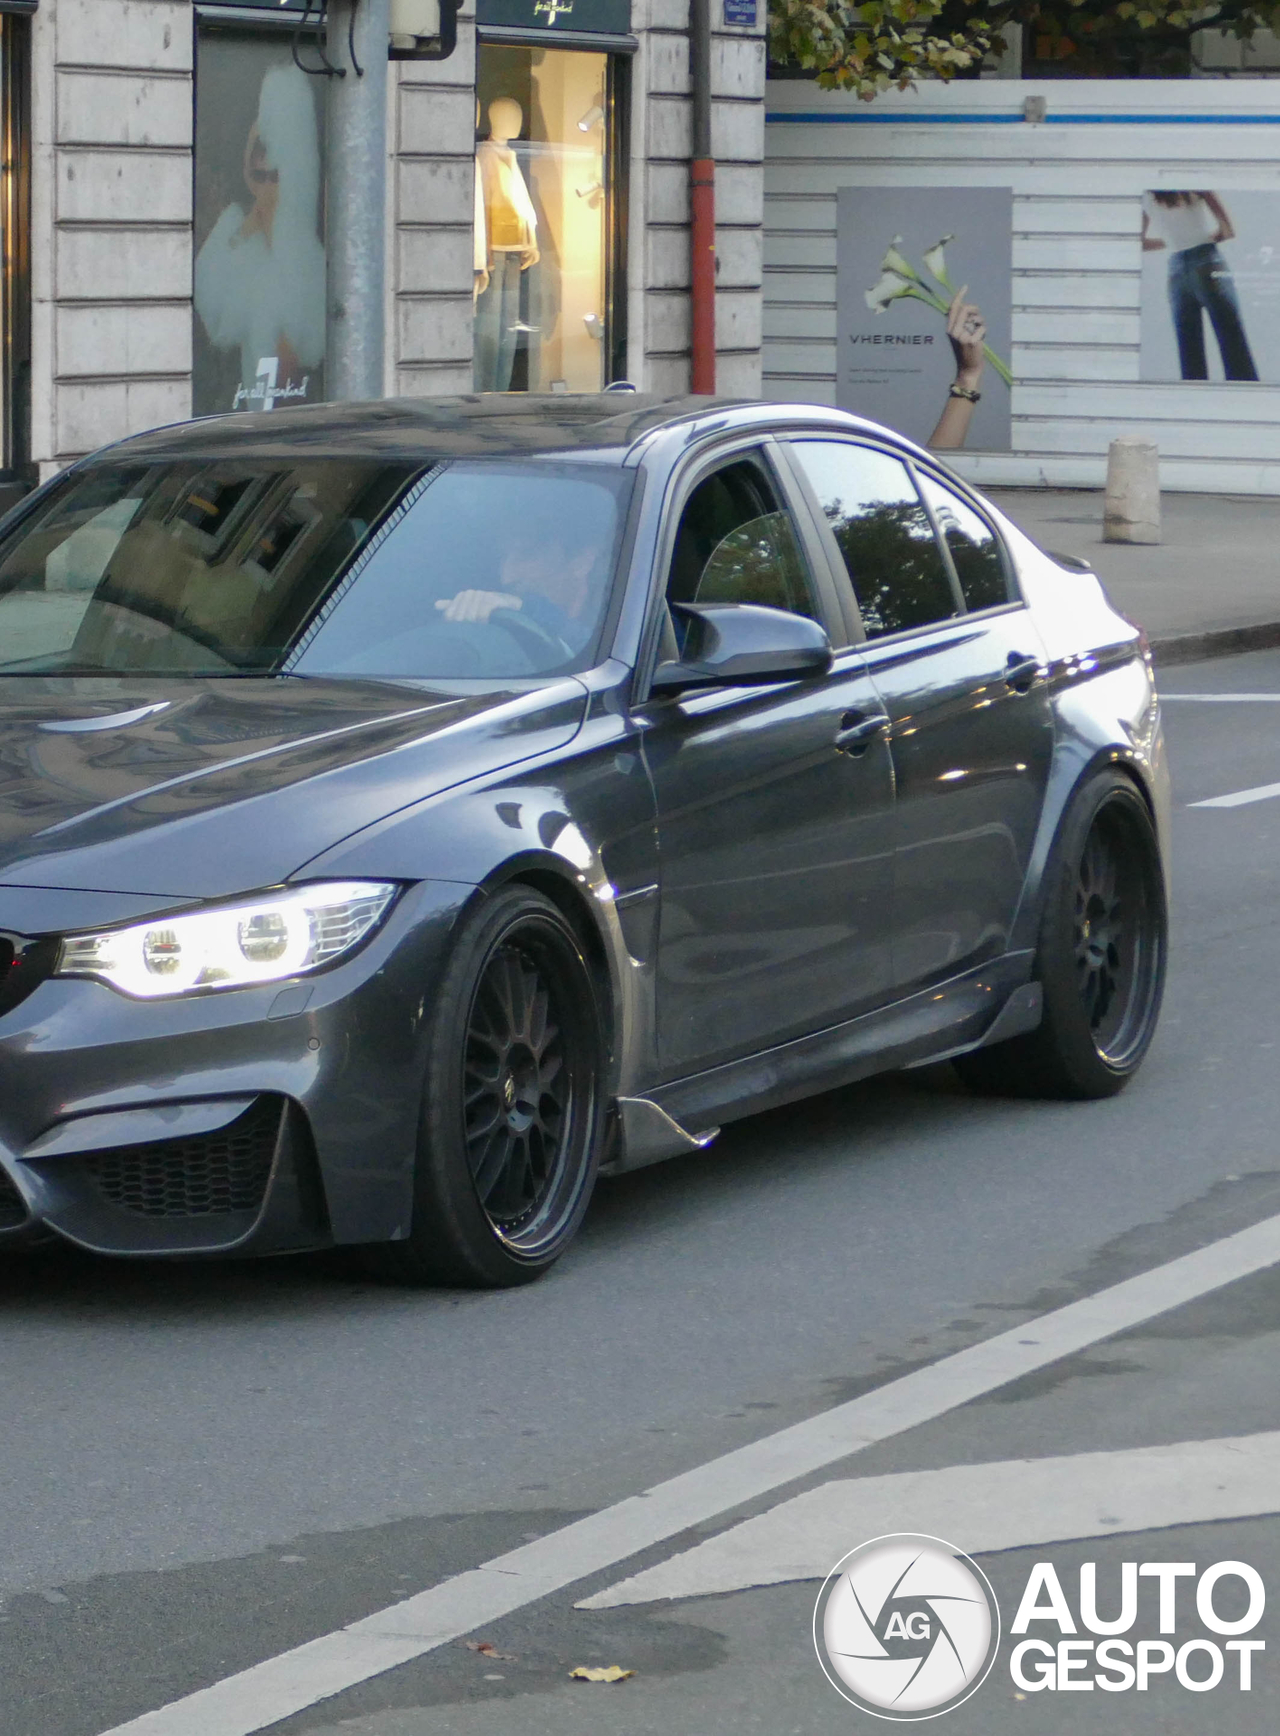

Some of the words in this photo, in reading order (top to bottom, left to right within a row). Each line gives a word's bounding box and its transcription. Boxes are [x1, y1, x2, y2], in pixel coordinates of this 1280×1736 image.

[849, 335, 934, 345] VHERNIER
[232, 382, 250, 409] for
[268, 376, 309, 398] mankind
